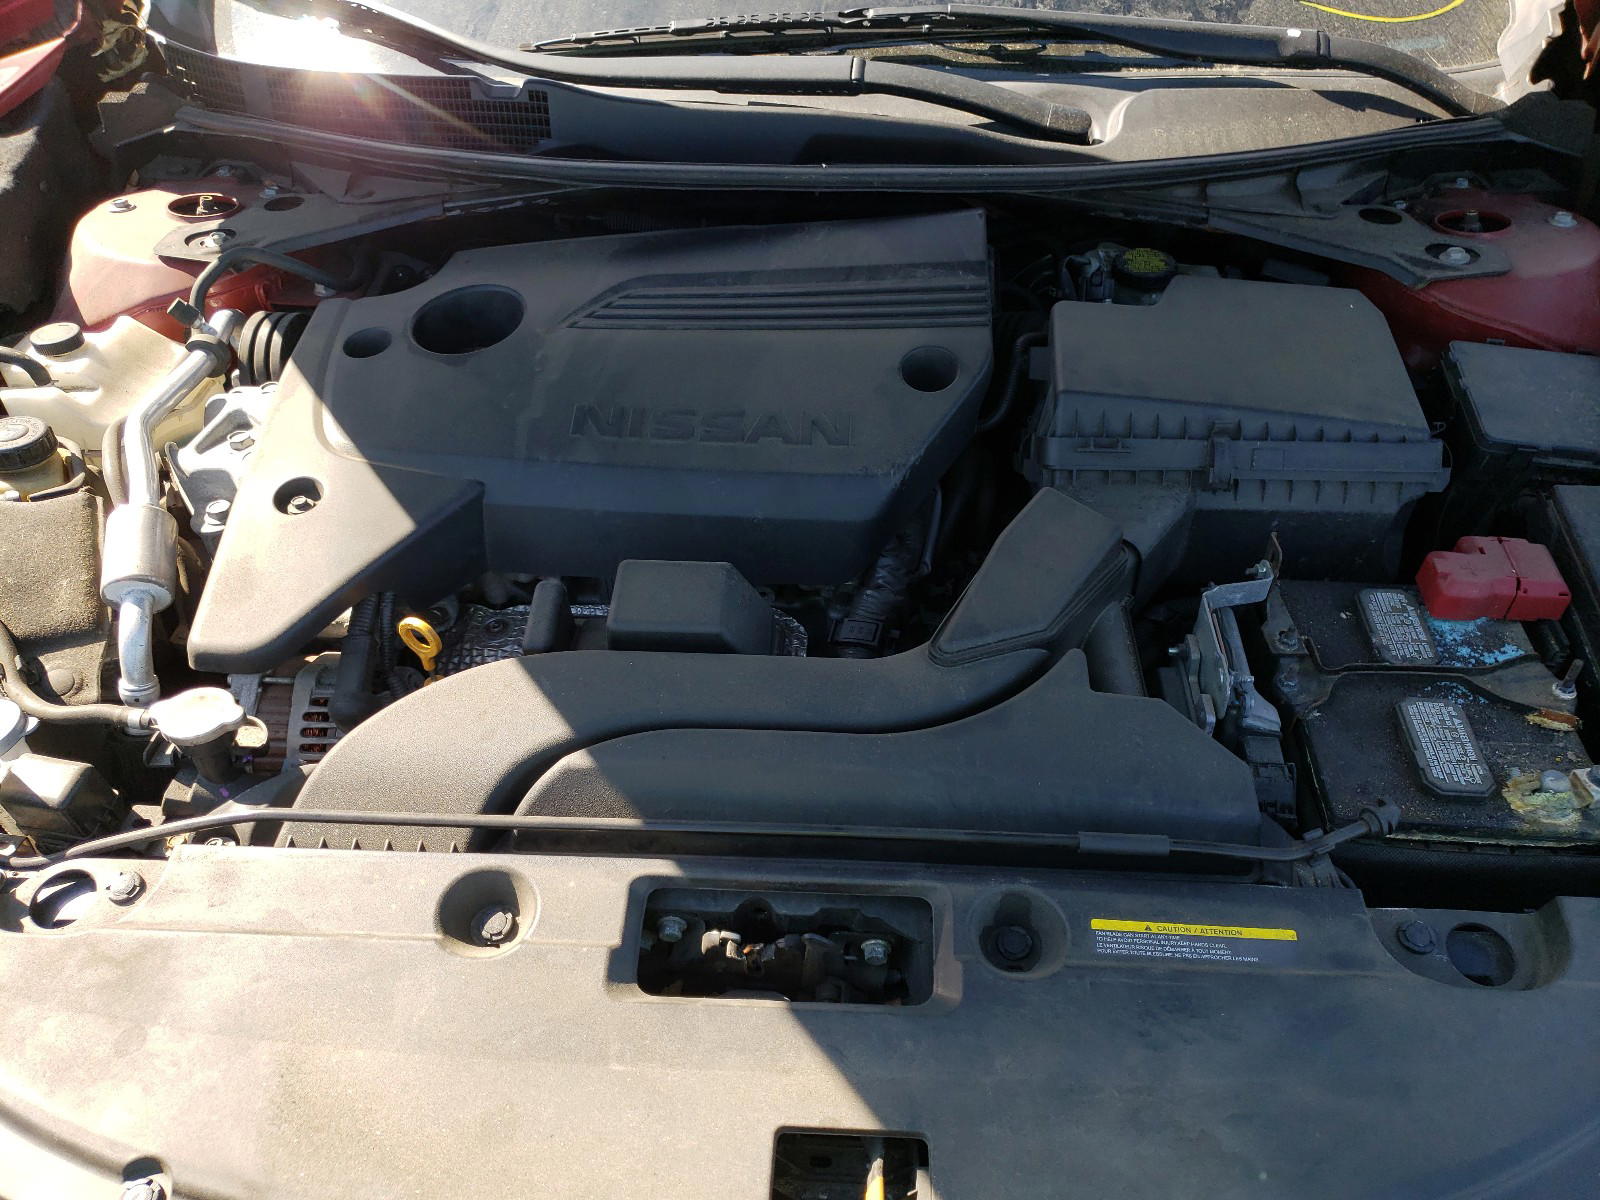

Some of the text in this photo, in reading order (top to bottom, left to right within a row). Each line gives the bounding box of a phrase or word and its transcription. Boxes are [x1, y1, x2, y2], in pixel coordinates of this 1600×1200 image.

[570, 402, 852, 447] NISSAN
[1156, 925, 1192, 933] CAUTION
[1200, 927, 1243, 936] ATTENTION
